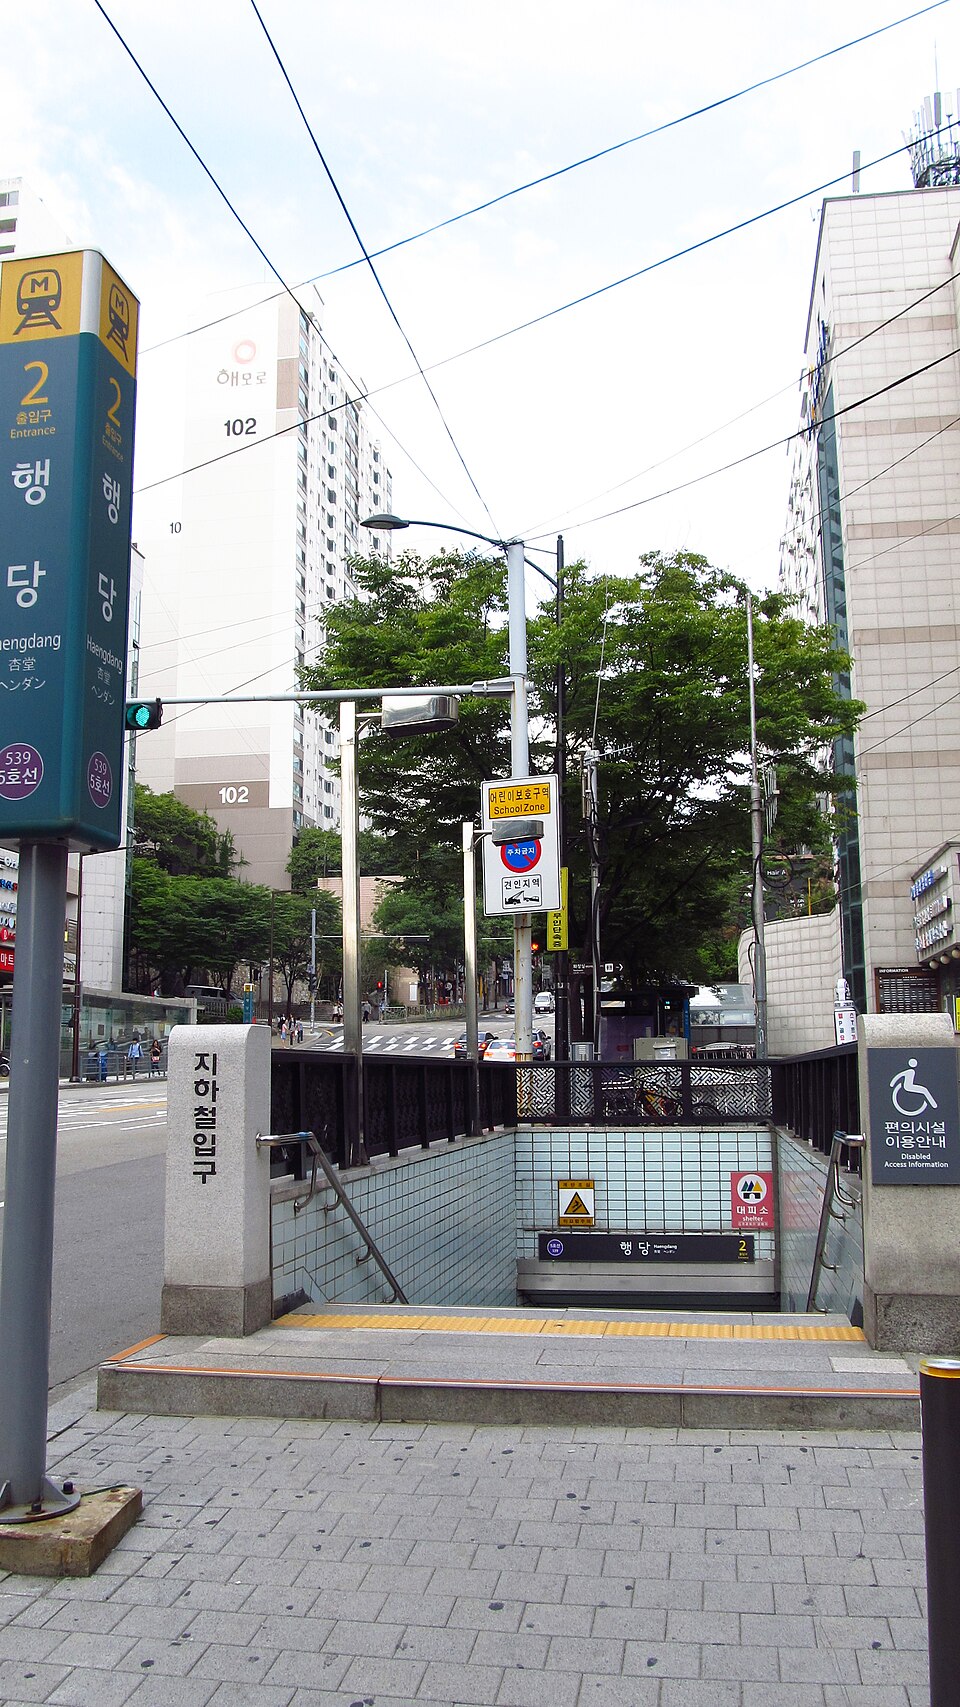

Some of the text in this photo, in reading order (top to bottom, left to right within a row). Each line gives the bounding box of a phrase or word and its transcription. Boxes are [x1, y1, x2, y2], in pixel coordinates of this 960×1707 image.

[31, 277, 49, 293] M
[20, 361, 49, 406] 2
[107, 377, 121, 428] 2
[16, 409, 53, 425] 출입구
[10, 427, 56, 439] Entrance
[224, 418, 257, 436] 102
[86, 634, 123, 674] Haengdang
[8, 657, 37, 671] 杏堂
[5, 751, 31, 765] 539
[94, 758, 107, 776] 539
[90, 774, 110, 797] 5호선
[218, 786, 249, 804] 102
[490, 786, 549, 803] 어린이보호구역
[494, 804, 545, 815] School Zone
[507, 847, 535, 856] 주차금지
[504, 878, 540, 890] 견인지역
[192, 1052, 219, 1184] 지하철입구
[884, 1121, 946, 1134] 편의시설
[885, 1136, 946, 1148] 이용안내
[736, 1205, 769, 1215] 대피소
[739, 1240, 747, 1251] 2
